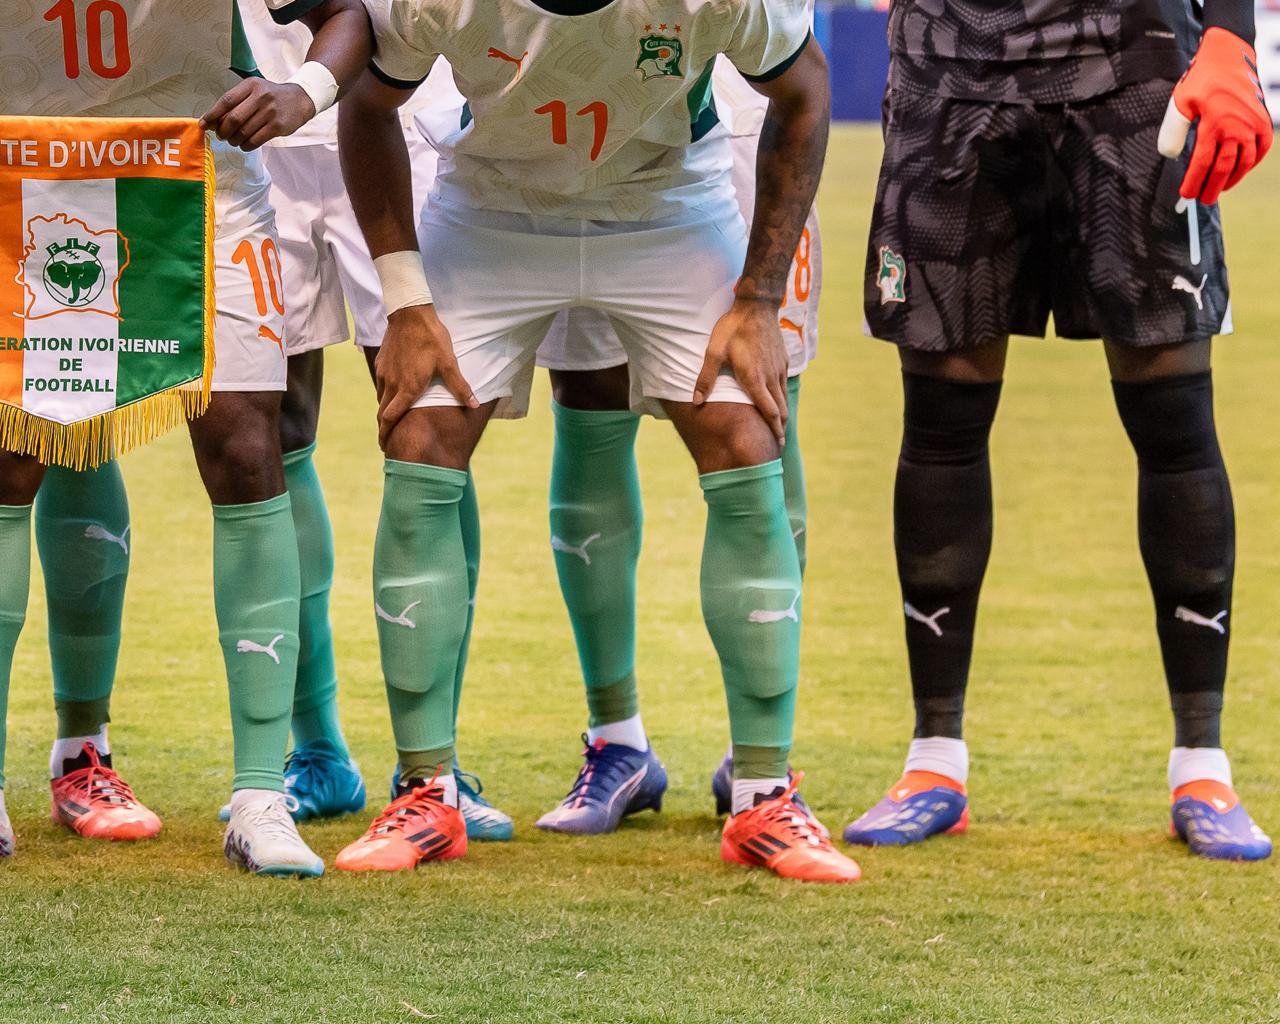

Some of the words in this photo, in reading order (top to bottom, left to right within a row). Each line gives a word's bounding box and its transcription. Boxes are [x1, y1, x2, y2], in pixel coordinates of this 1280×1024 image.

[534, 100, 608, 161] 11
[49, 138, 182, 168] D'IVOIRE
[1175, 197, 1201, 265] 1
[231, 238, 285, 316] 10
[79, 337, 180, 354] IVOIRIENNE
[59, 358, 83, 372] DE
[25, 378, 114, 393] FOOTBALL
